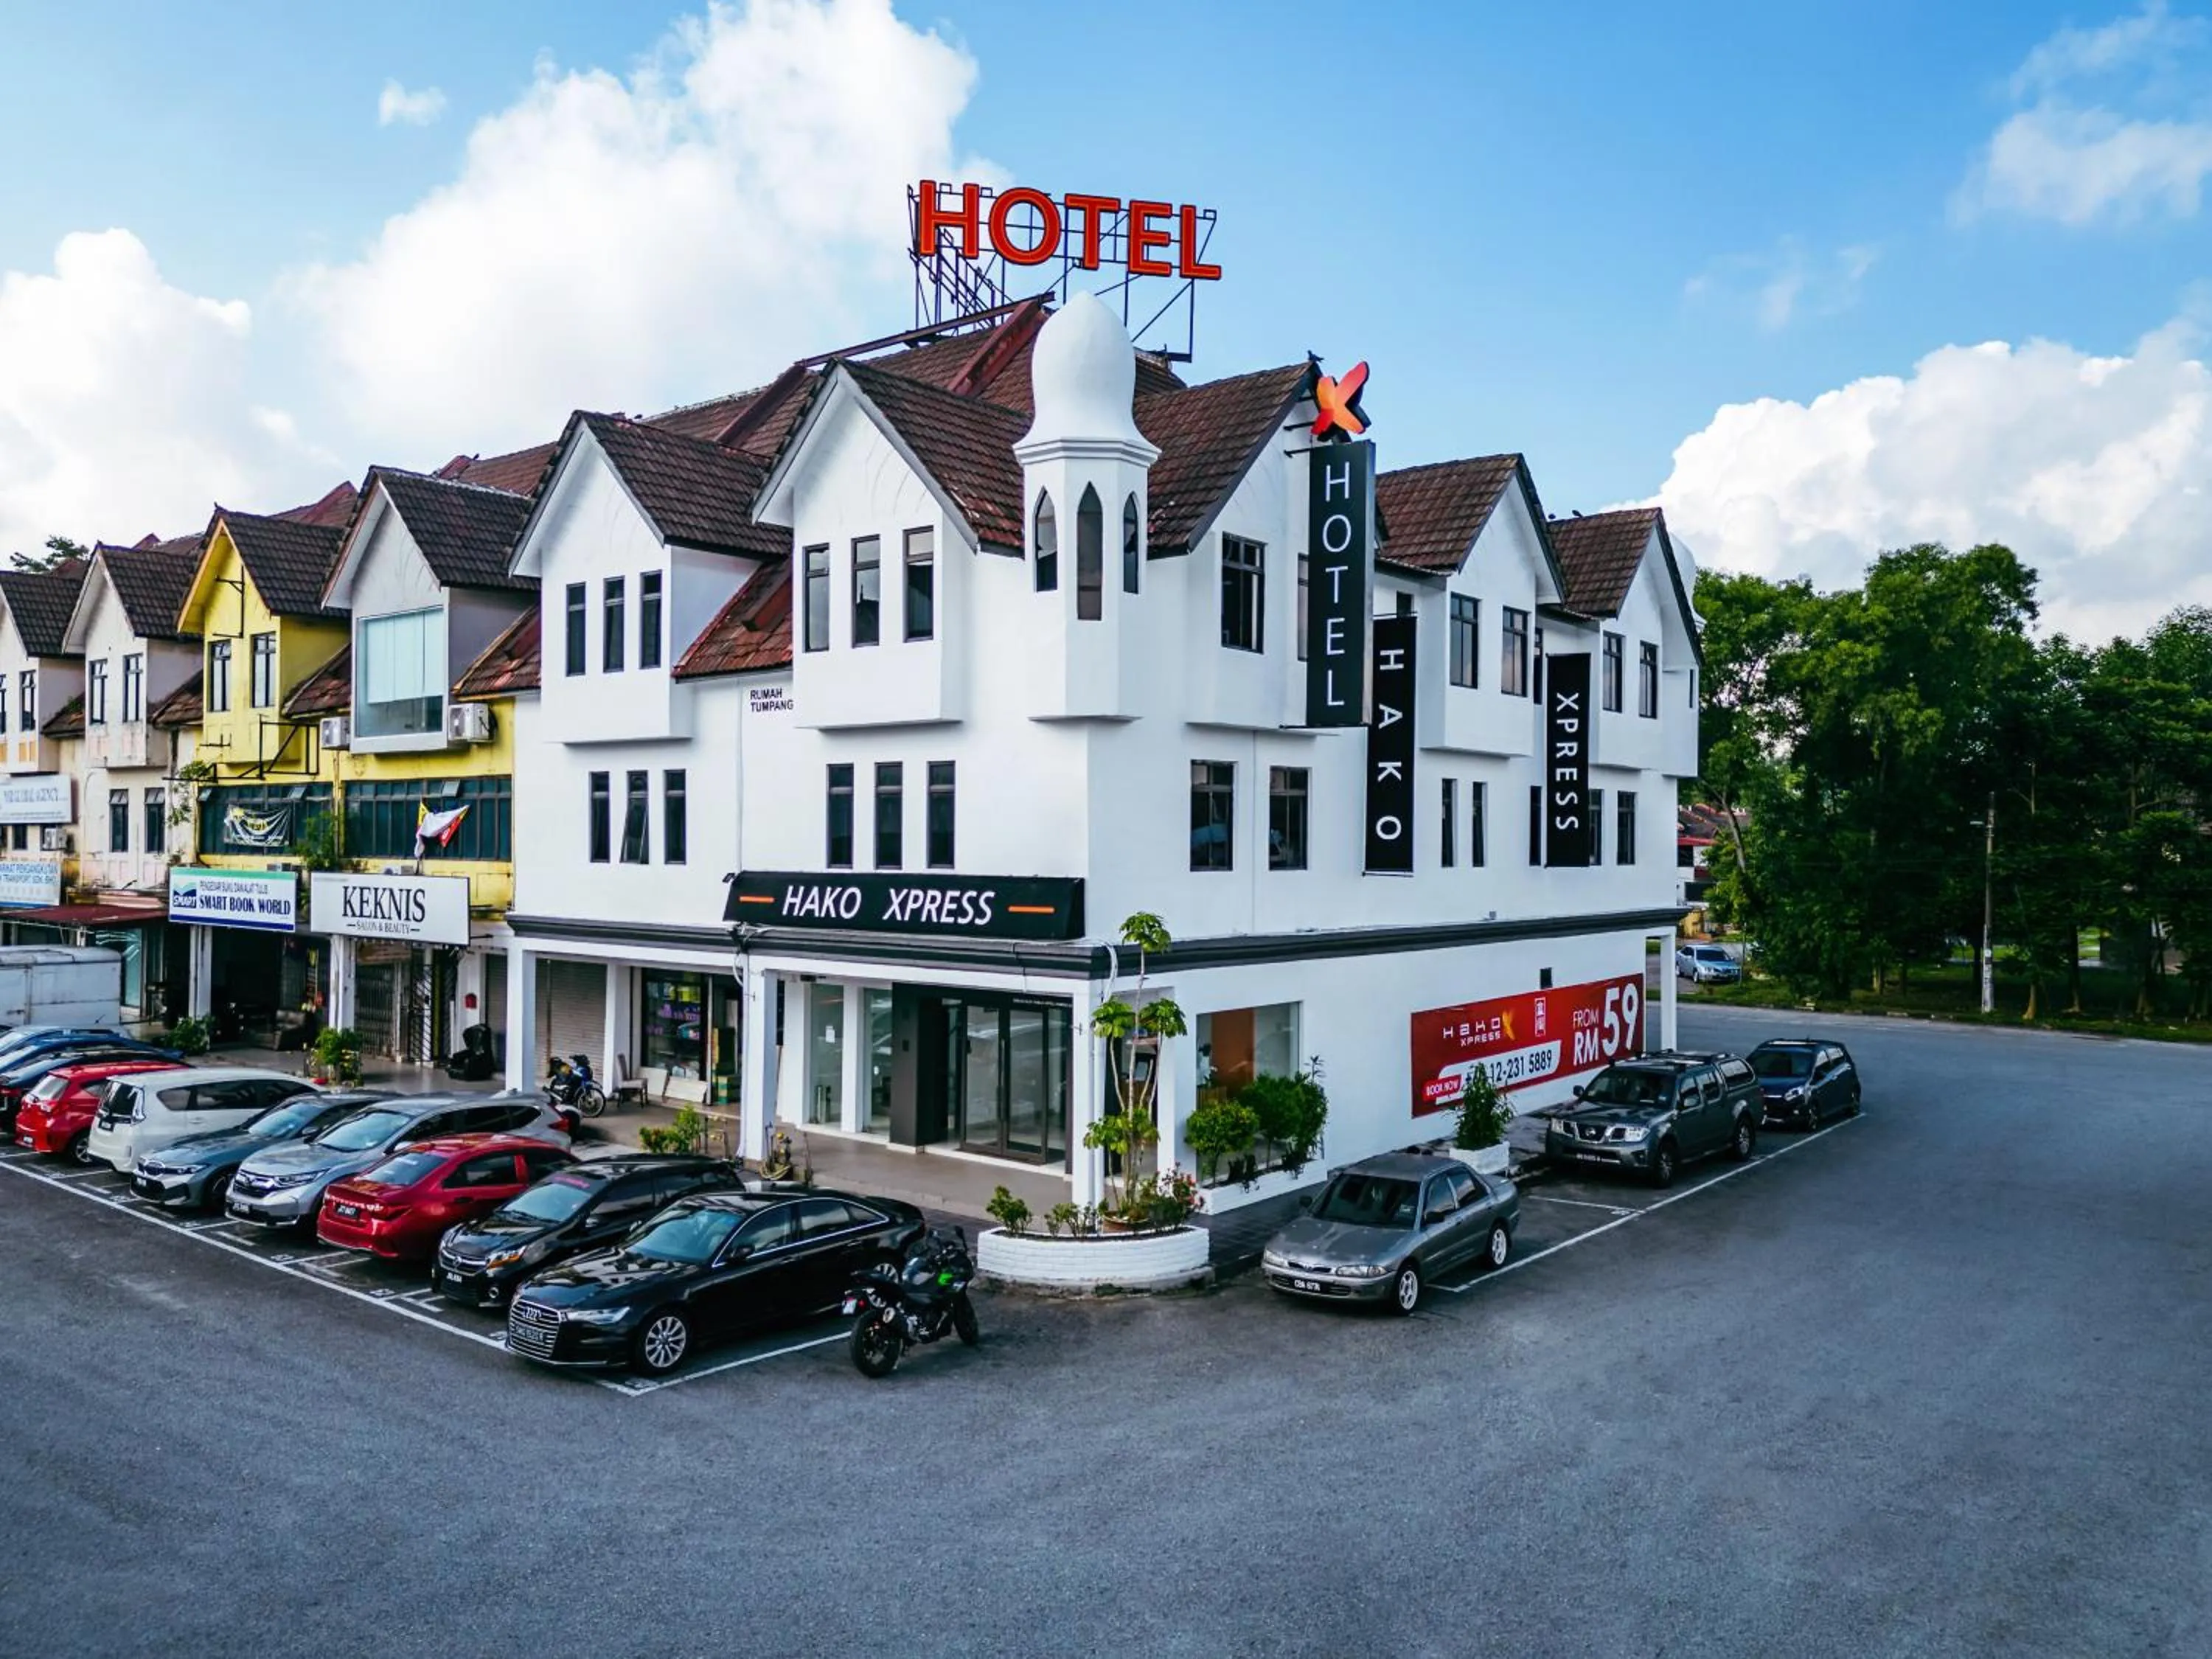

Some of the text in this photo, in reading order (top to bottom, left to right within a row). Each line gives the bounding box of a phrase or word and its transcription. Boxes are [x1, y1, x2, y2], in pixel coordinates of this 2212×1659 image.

[919, 179, 1222, 280] HOTEL
[1322, 461, 1352, 706] HOTEL
[750, 687, 782, 700] RUMAH
[751, 700, 794, 712] TUMPANG
[1376, 648, 1405, 841] HAKO
[1555, 692, 1579, 830] XPRESS
[199, 895, 291, 915] SMART BOOK WORLD
[342, 886, 425, 922] KEKNIS
[782, 885, 995, 925] HAKO XPRESS
[356, 920, 378, 931] SALON
[384, 923, 411, 934] BEAUTY
[1573, 1007, 1599, 1029] FROM
[1601, 983, 1639, 1057] 59
[1461, 1030, 1501, 1047] XPRESS
[1573, 1029, 1599, 1066] RM
[1528, 1049, 1552, 1074] 5889
